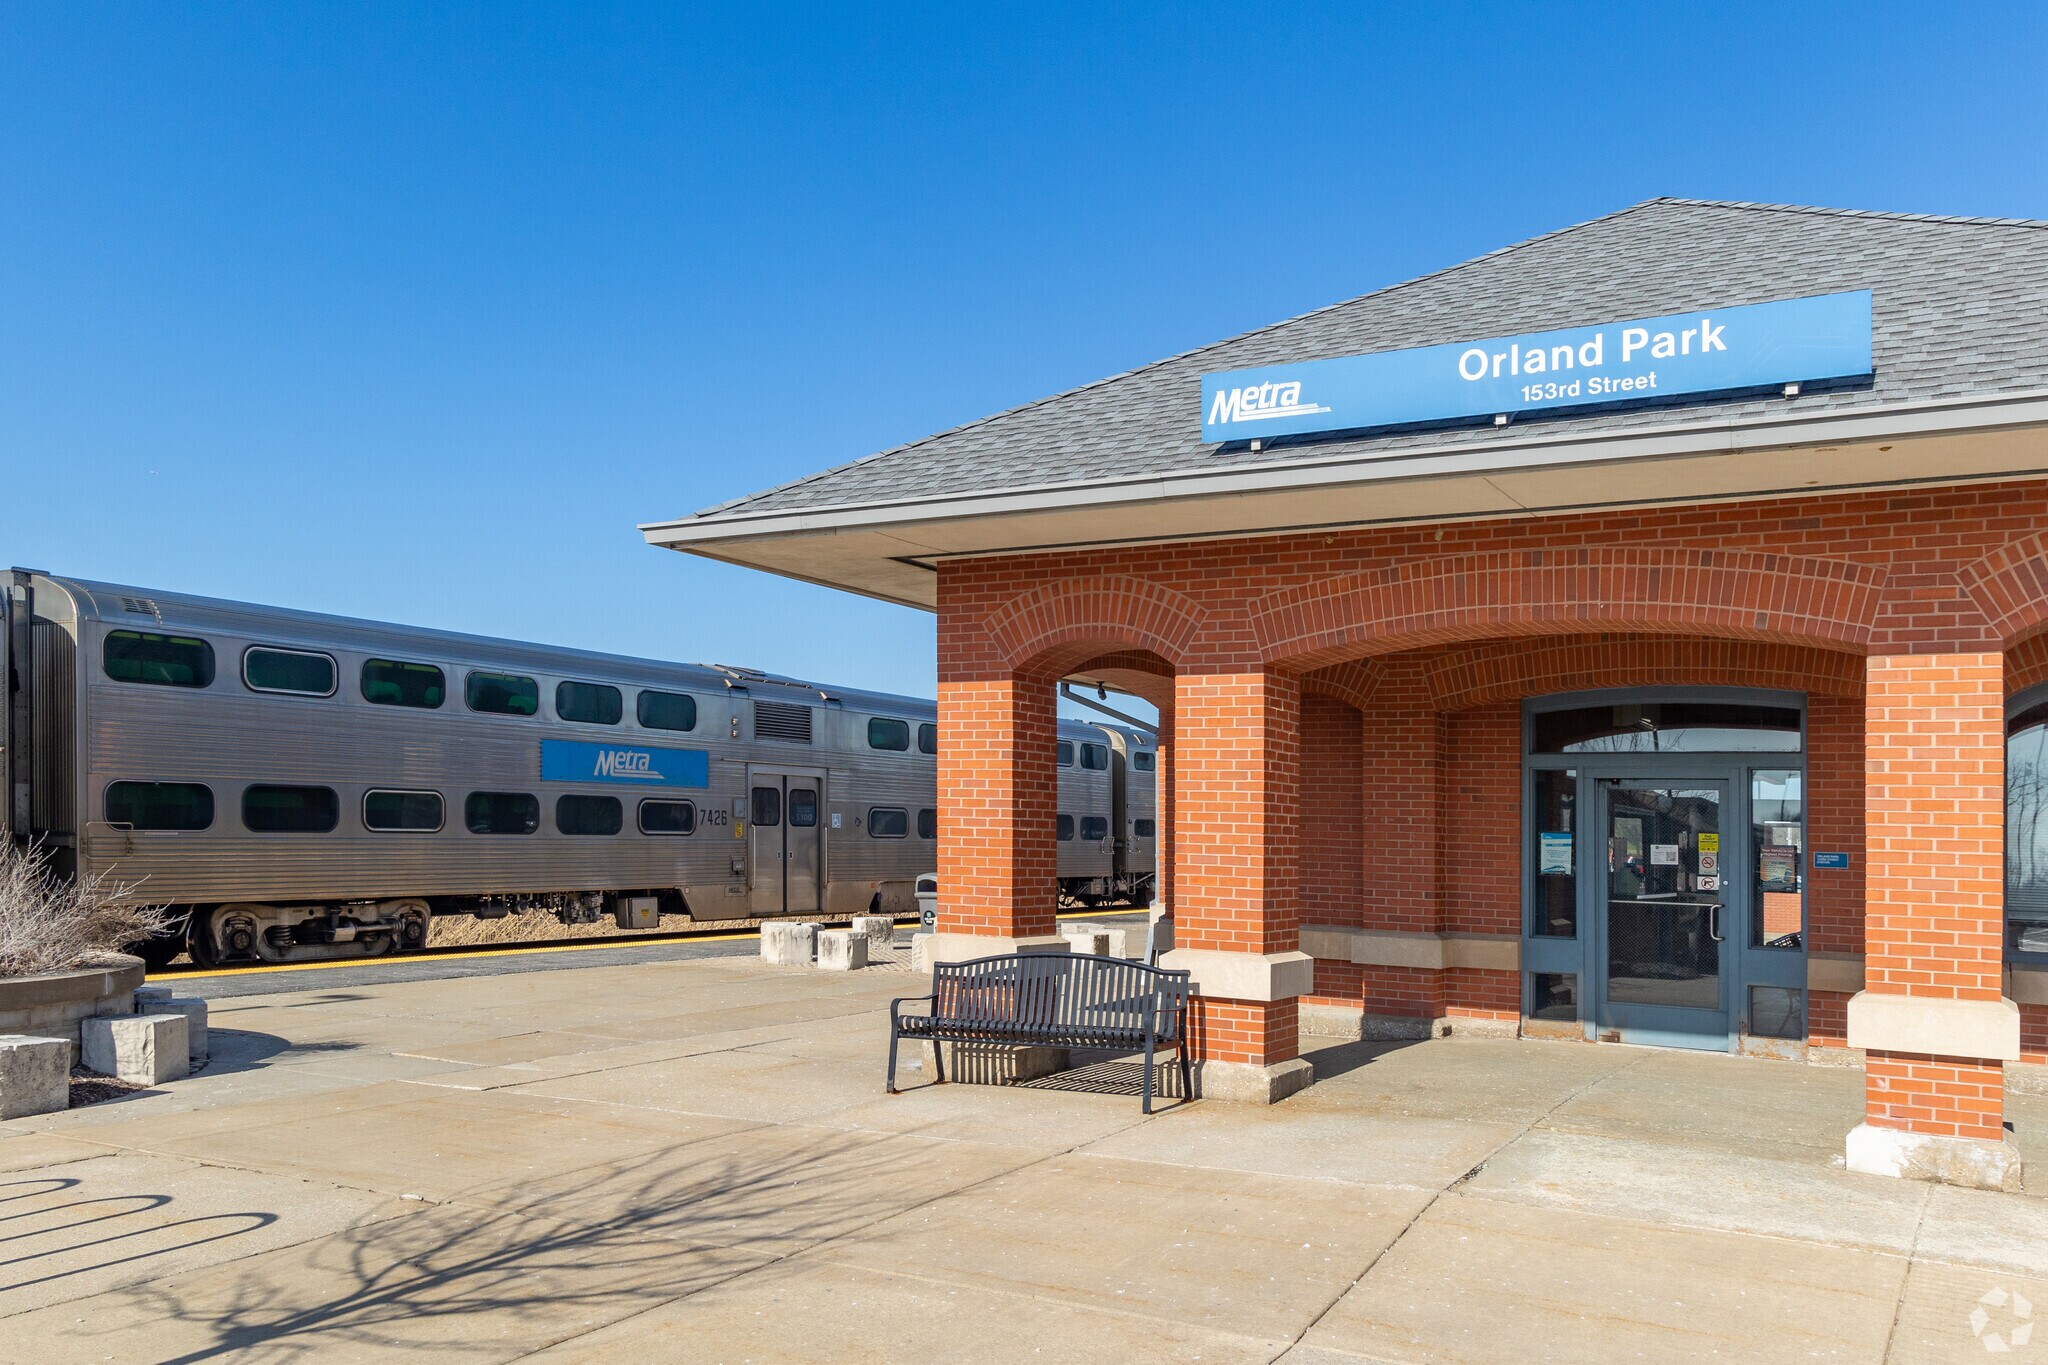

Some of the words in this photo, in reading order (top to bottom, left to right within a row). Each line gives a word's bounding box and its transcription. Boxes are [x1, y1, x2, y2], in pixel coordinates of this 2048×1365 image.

[1458, 333, 1603, 381] Orland
[1622, 319, 1728, 362] Park
[1521, 379, 1580, 402] 153rd
[1588, 371, 1657, 395] Street
[1207, 380, 1301, 425] Metra
[593, 750, 651, 777] Metra
[700, 809, 728, 826] 7426
